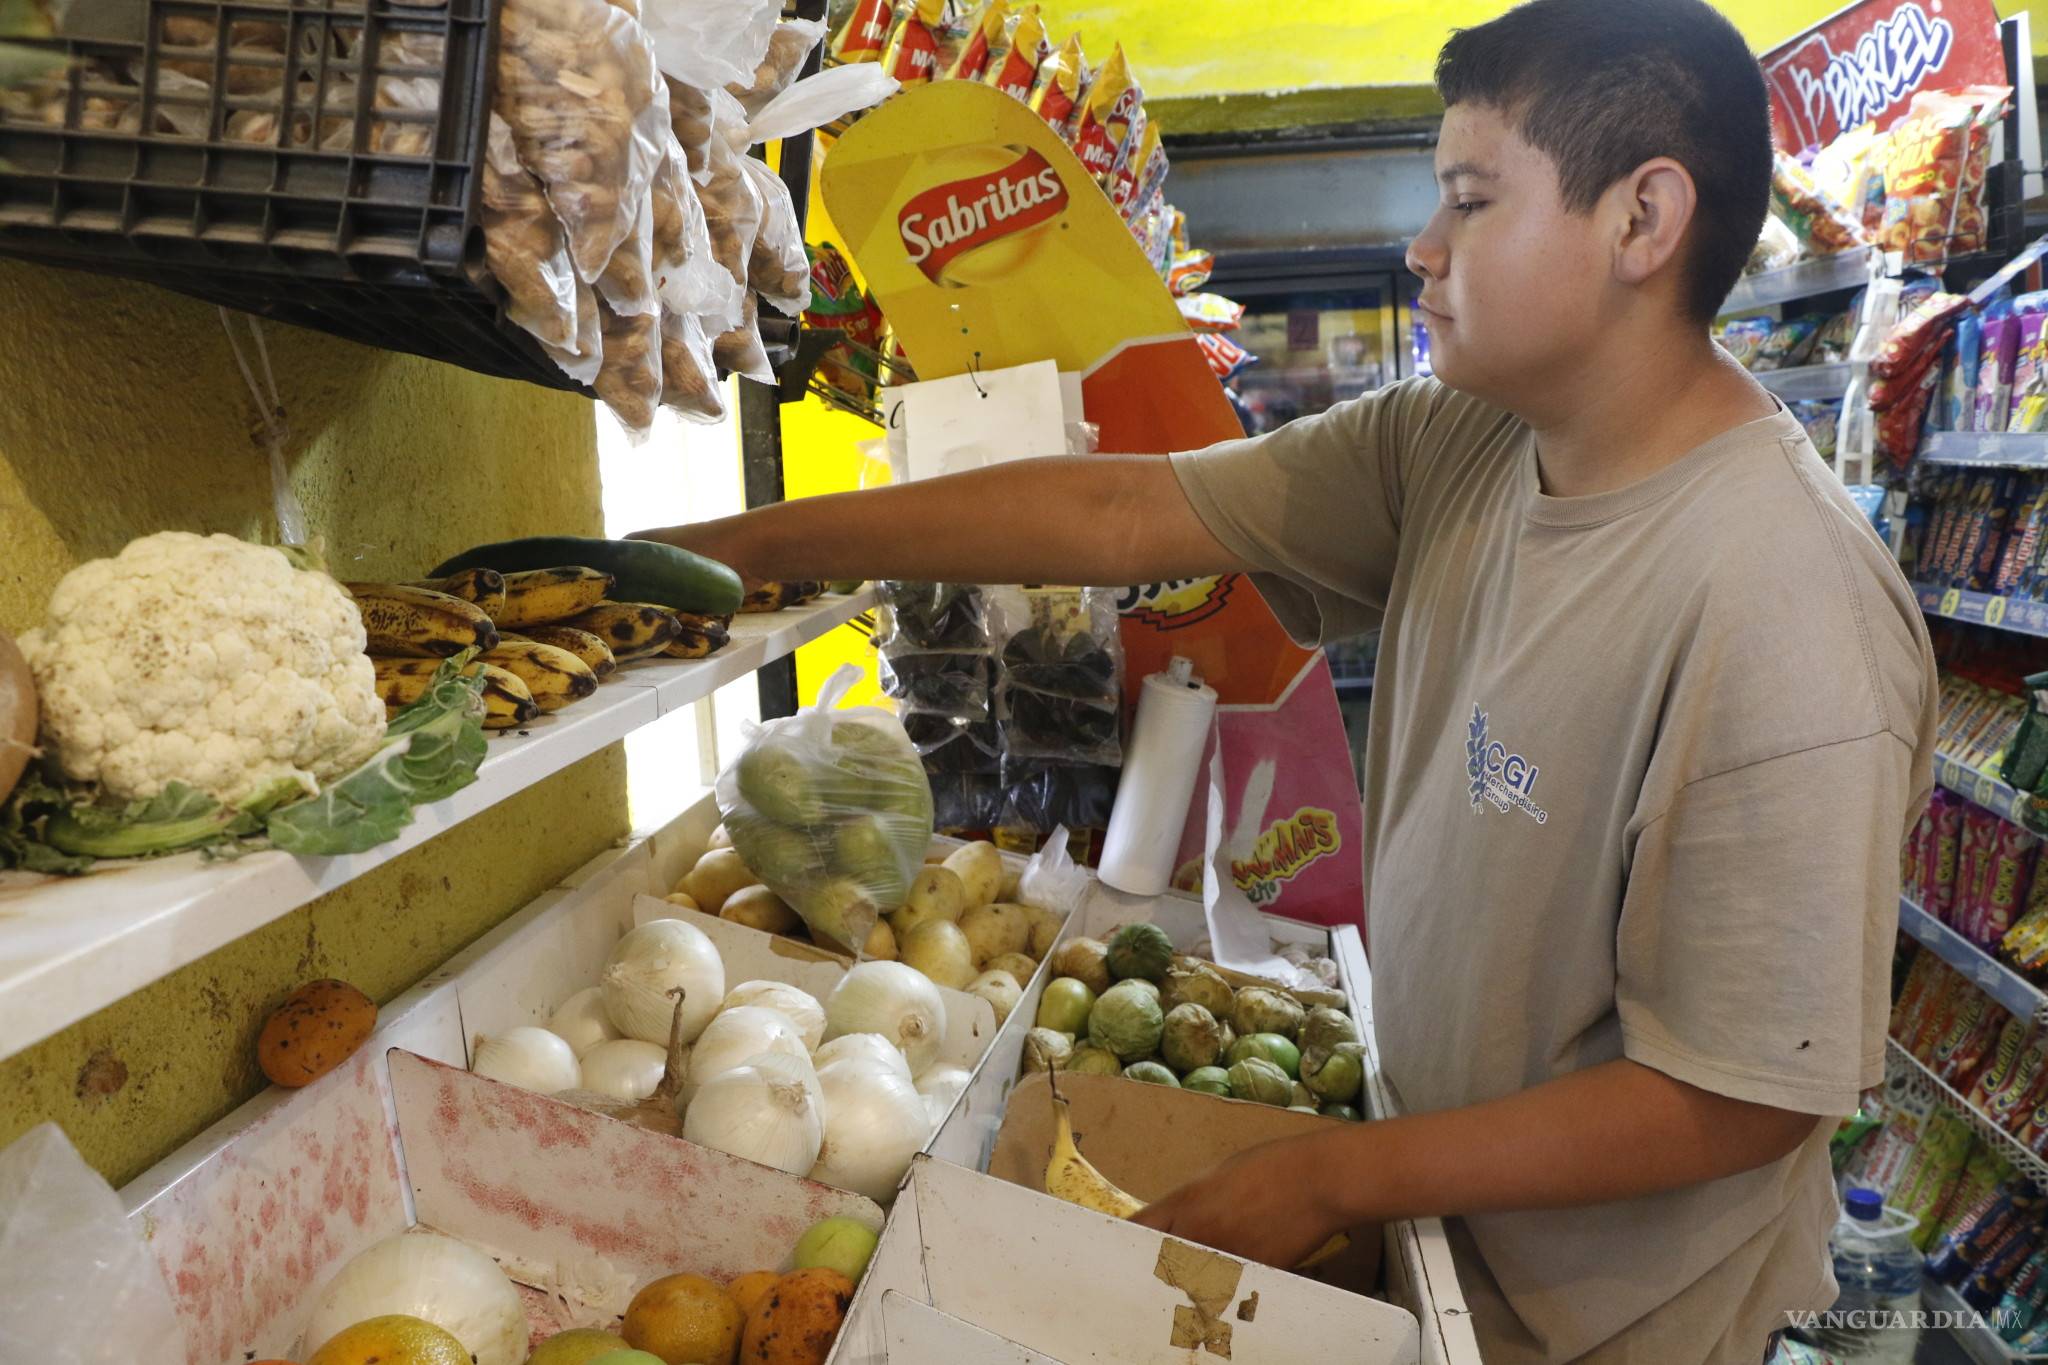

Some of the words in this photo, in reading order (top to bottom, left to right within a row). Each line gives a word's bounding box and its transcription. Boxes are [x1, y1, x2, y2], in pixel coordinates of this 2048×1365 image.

[1824, 6, 1951, 133] BARCEL
[899, 166, 1062, 264] Sabritas
[1486, 742, 1539, 795] CGI
[1483, 771, 1547, 822] Merchandising
[1484, 786, 1509, 811] Group
